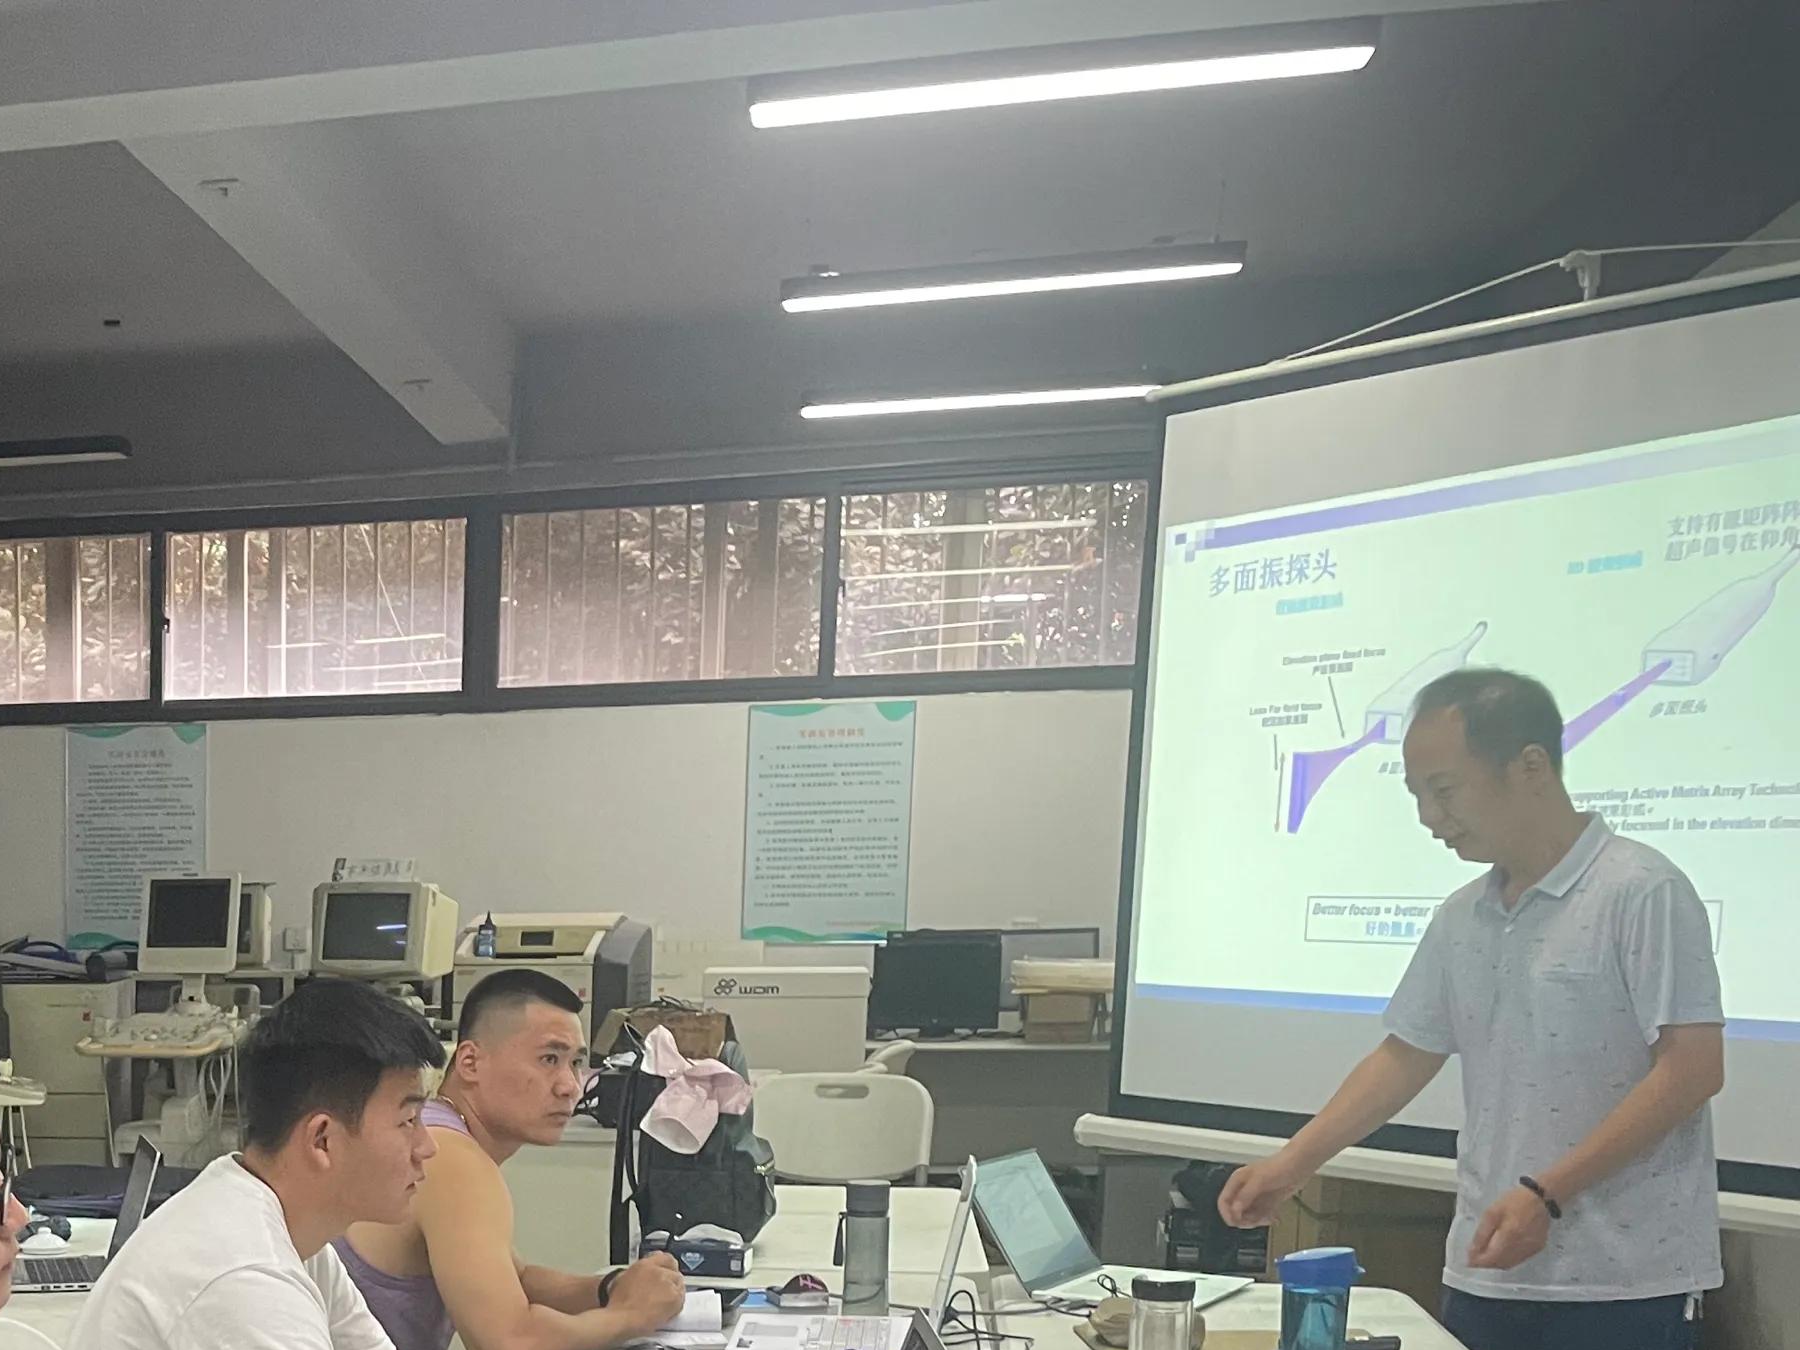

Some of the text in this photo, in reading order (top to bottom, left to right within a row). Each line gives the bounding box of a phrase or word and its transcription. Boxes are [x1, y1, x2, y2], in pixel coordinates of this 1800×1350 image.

[1208, 548, 1337, 598] 多面振探头
[1712, 784, 1746, 799] Array
[1687, 817, 1707, 829] the
[1710, 816, 1766, 829] elevation
[1312, 903, 1347, 915] Better
[1349, 904, 1381, 916] focus
